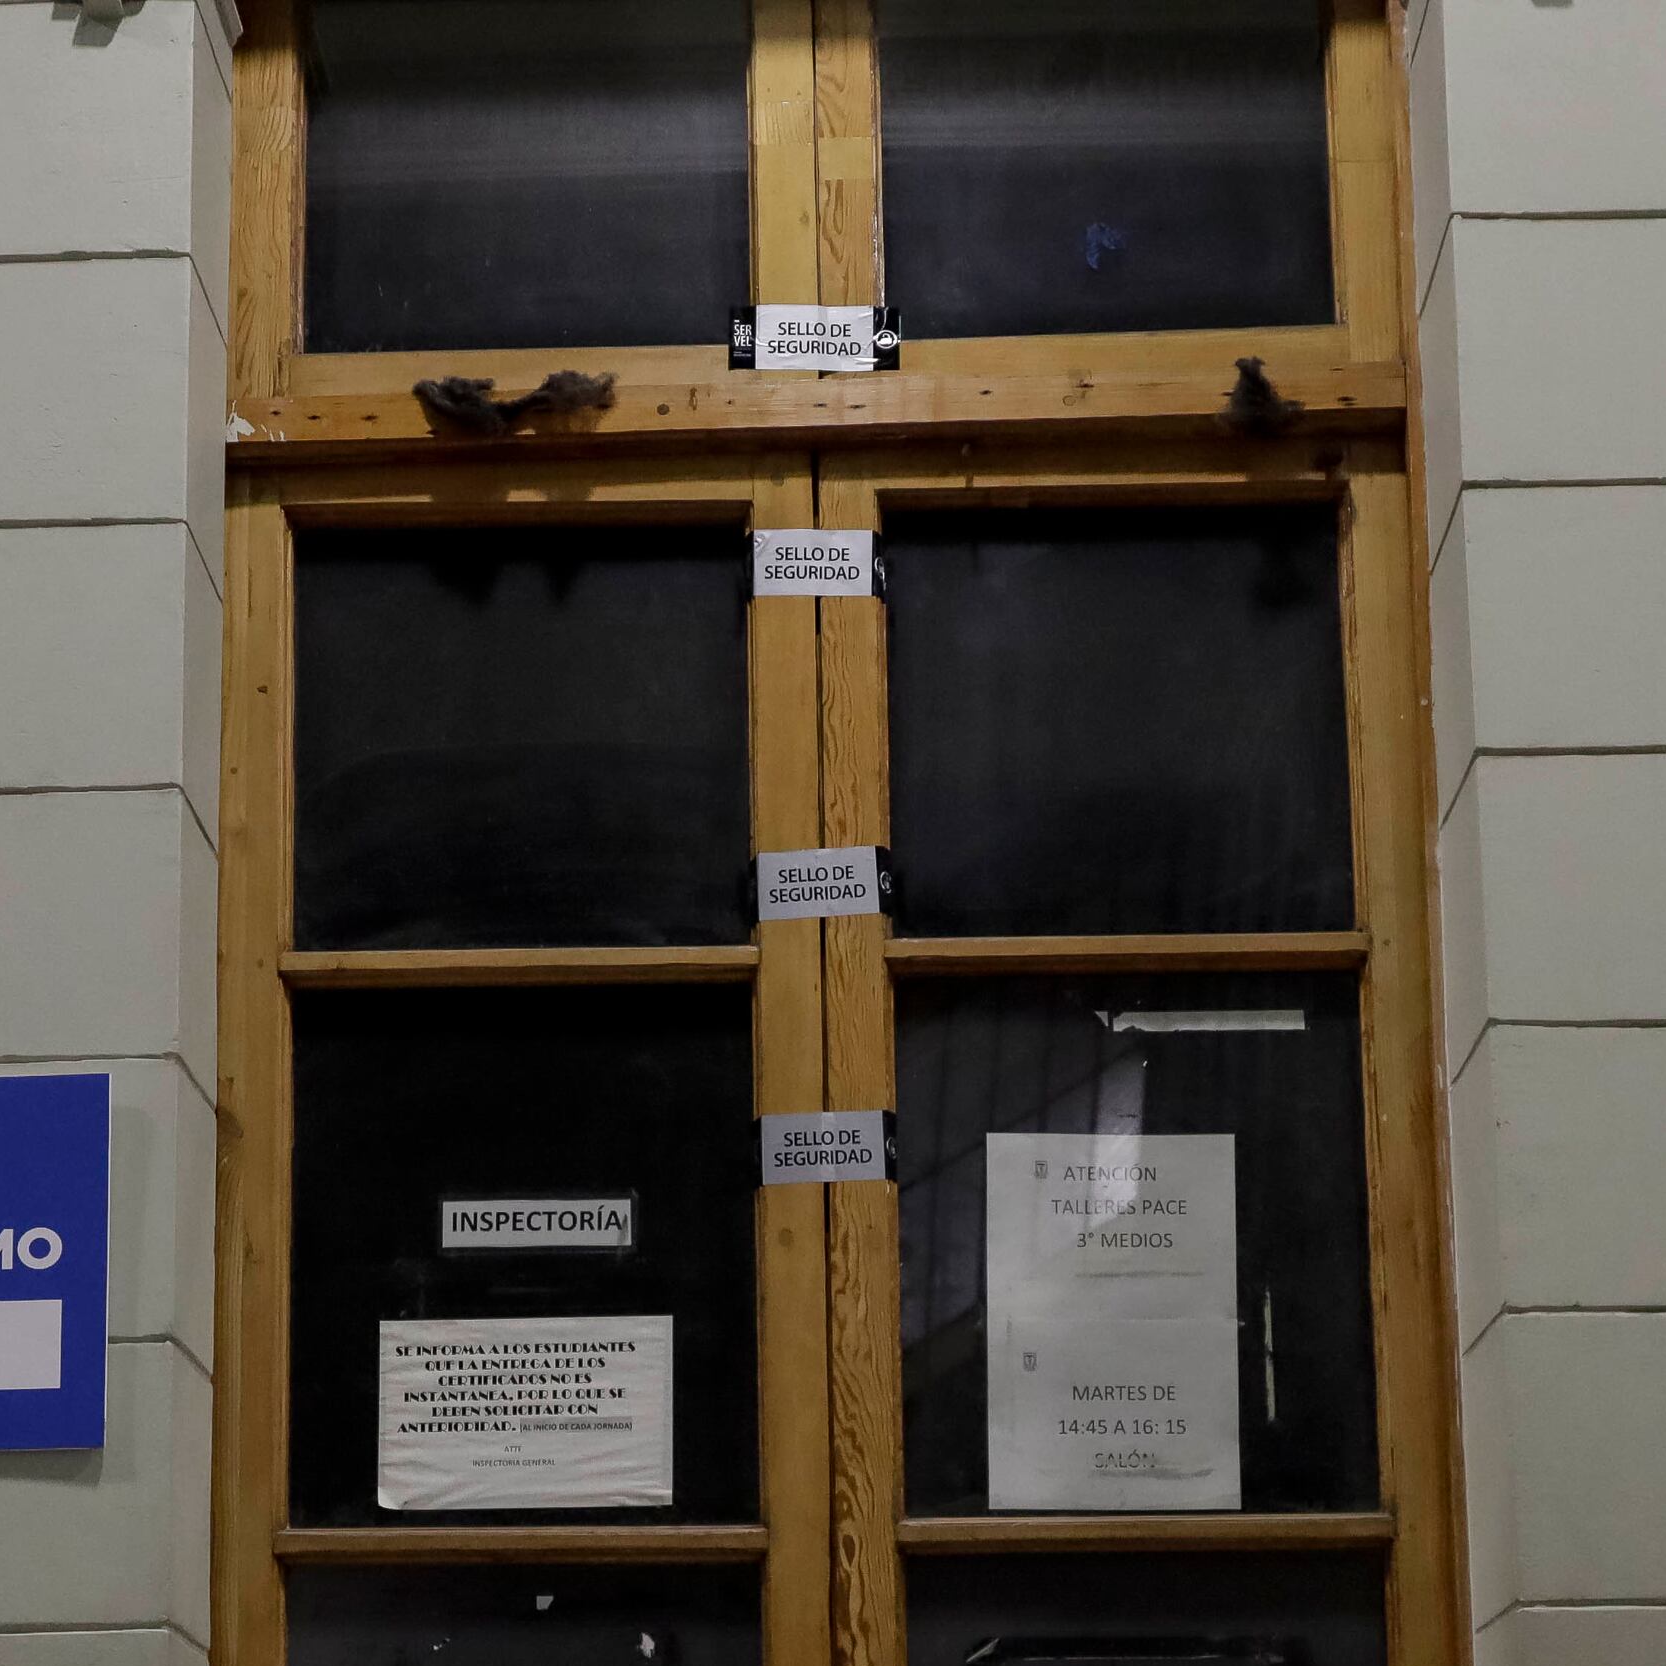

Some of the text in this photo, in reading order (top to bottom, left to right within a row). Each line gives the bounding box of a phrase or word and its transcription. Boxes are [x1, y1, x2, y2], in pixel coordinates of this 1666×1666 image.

[734, 324, 752, 336] SER
[778, 322, 852, 337] SELLO DE
[734, 336, 752, 347] VEL
[768, 340, 861, 356] SEGURIDAD
[775, 547, 850, 561] SELLO DE
[764, 565, 860, 580] SEGURIDAD
[778, 865, 855, 884] SELLO DE
[769, 883, 867, 903] SEGURIDAD
[783, 1129, 861, 1147] SELLO DE
[774, 1148, 873, 1168] SEGURIDAD
[1064, 1163, 1157, 1181] ATENCIÓN
[1051, 1200, 1187, 1215] TALLERES PACE
[452, 1205, 623, 1232] INSPECTORÍA
[1101, 1233, 1173, 1248] MEDIOS
[395, 1341, 636, 1357] SE INFORMA A LOS ESTUDIANTES
[425, 1357, 606, 1371] QUE LA ENTREGA DE LOS
[438, 1373, 593, 1386] CERTIFICADOS NO ES
[517, 1389, 548, 1400] POR
[552, 1389, 572, 1400] LO
[575, 1388, 605, 1399] QUE
[609, 1388, 626, 1399] SE
[1072, 1385, 1176, 1401] MARTES DE
[432, 1403, 598, 1417] DEBEN SOLICITAR CON
[397, 1421, 516, 1433] ANTERIORIDAD.
[533, 1423, 557, 1431] INICIO
[559, 1423, 568, 1431] DE
[570, 1423, 591, 1431] CADA
[594, 1422, 633, 1431] JORNADA)
[1058, 1420, 1108, 1435] 14:45
[1114, 1420, 1126, 1435] A
[1166, 1419, 1187, 1435] 15
[1095, 1449, 1156, 1468] SALÓN
